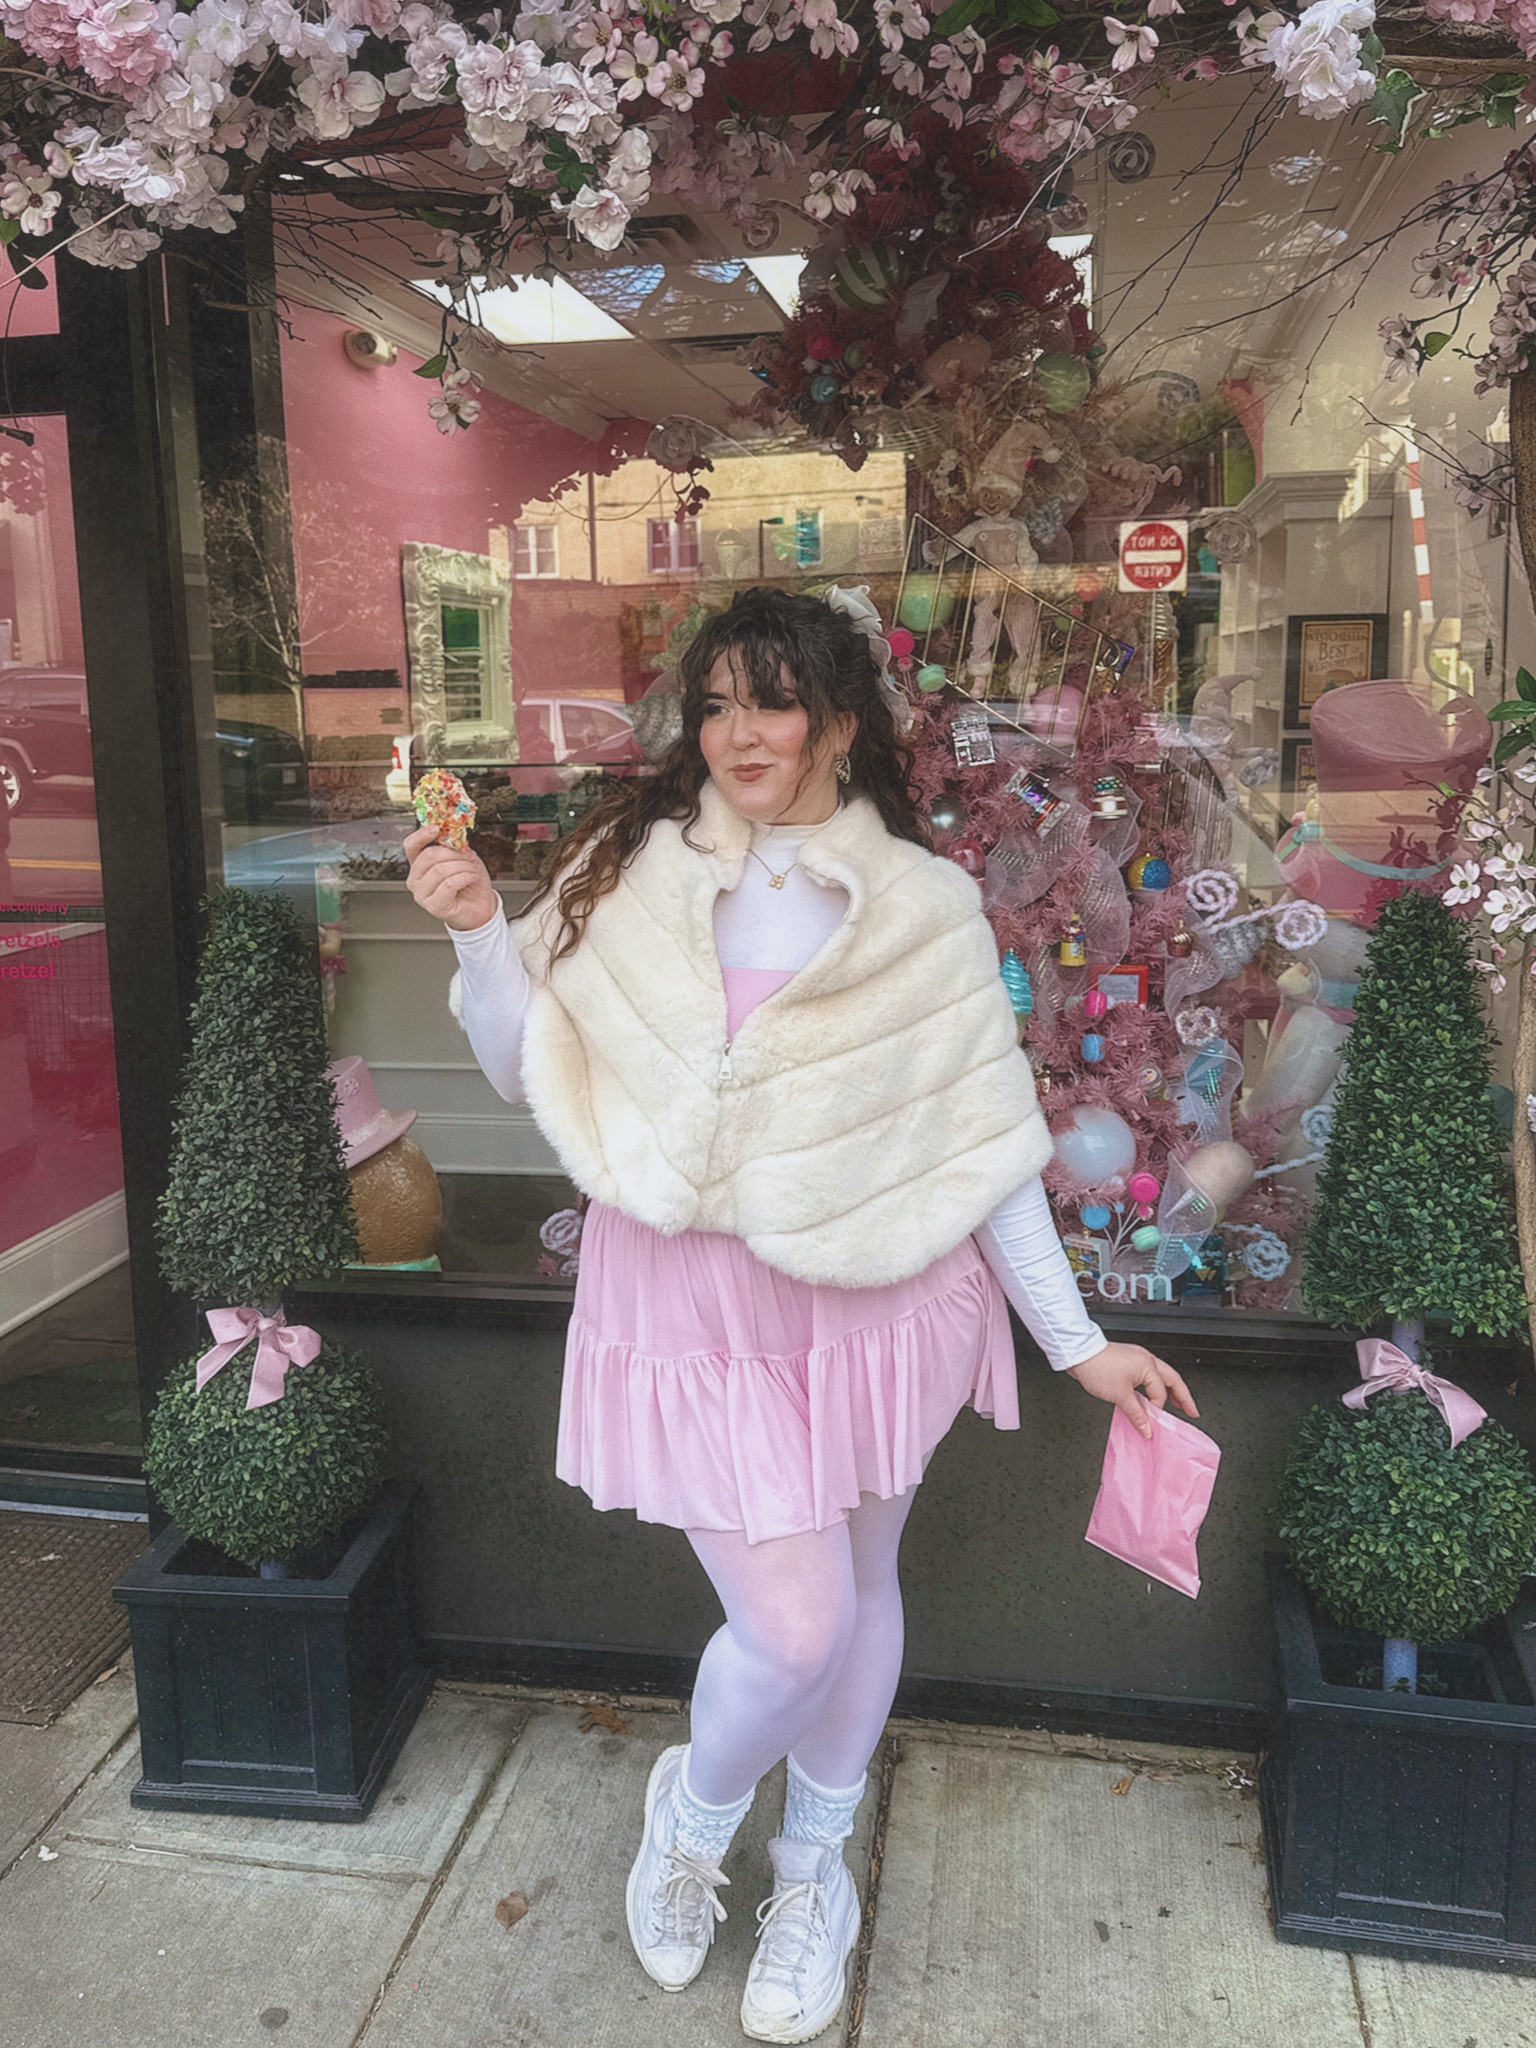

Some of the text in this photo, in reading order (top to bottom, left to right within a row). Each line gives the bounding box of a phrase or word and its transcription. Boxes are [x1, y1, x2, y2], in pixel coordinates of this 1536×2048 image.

[1306, 631, 1368, 641] WESTCHESTER
[0, 962, 55, 979] retzel
[1075, 1270, 1173, 1301] com
